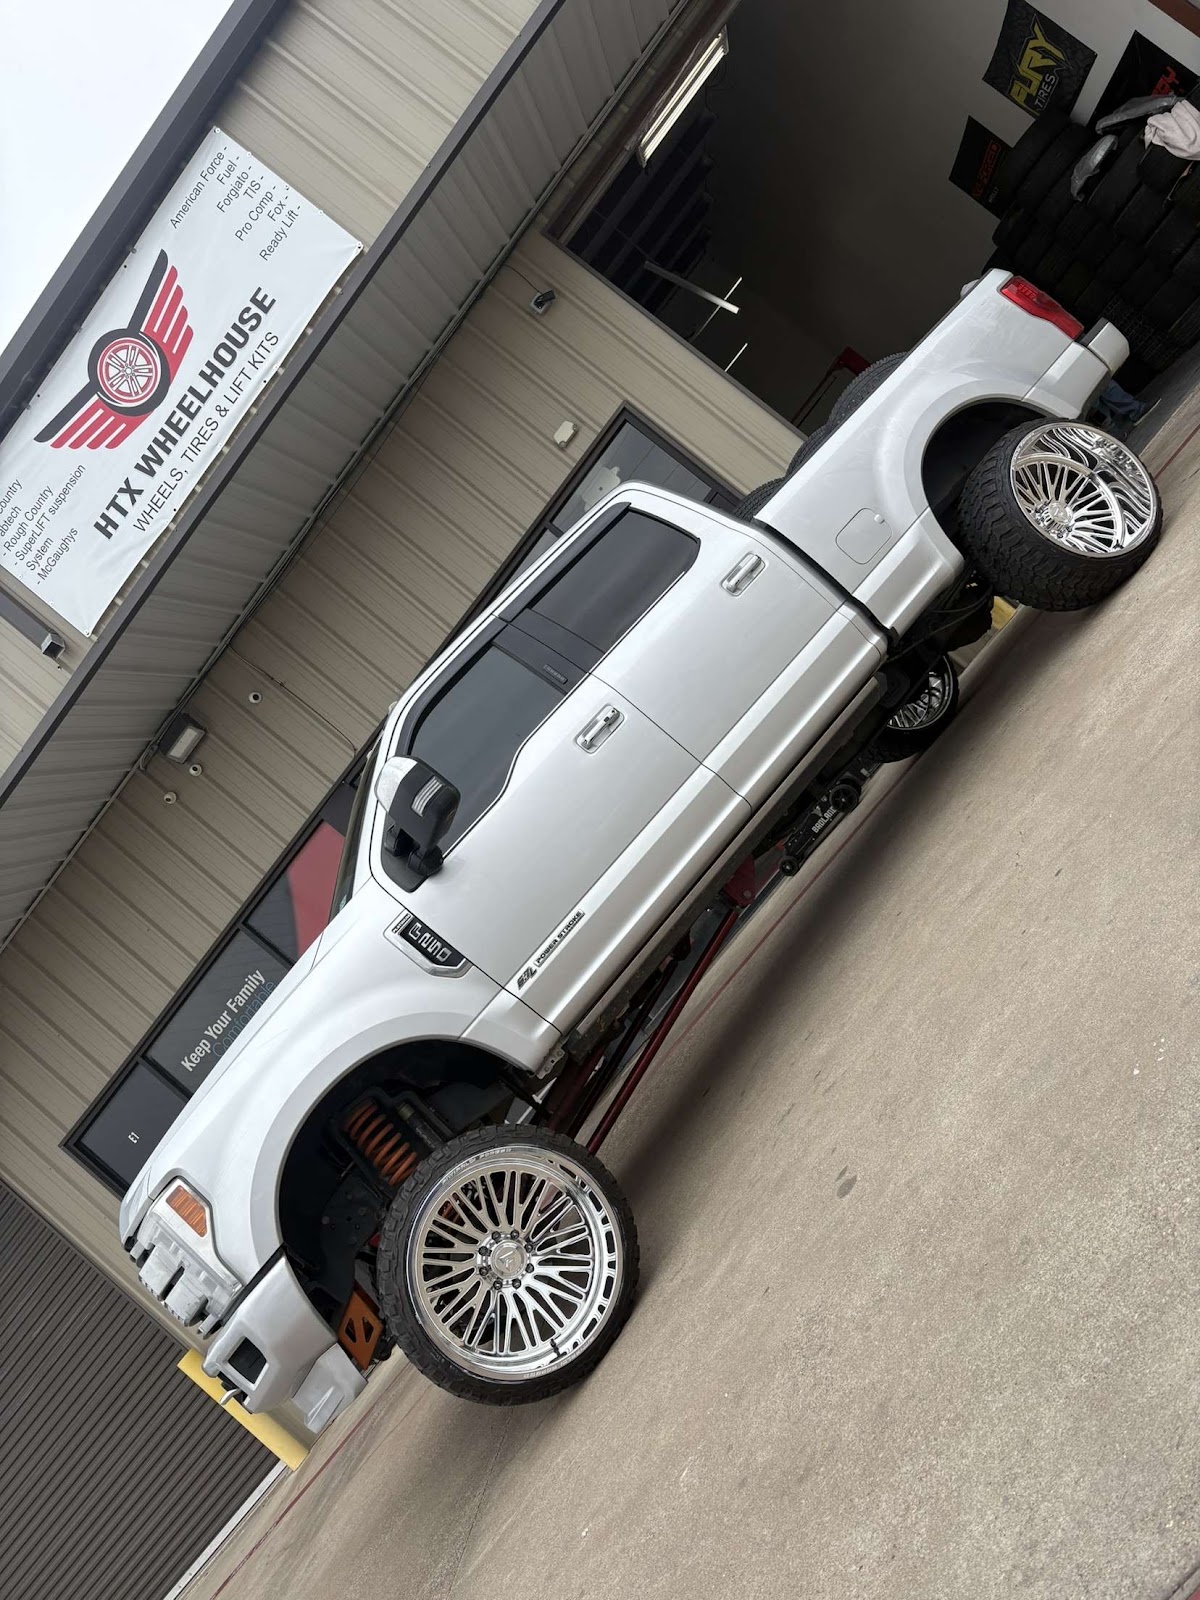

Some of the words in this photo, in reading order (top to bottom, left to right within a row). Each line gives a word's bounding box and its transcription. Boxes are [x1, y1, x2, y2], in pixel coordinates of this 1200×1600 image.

[1009, 22, 1066, 116] FURY
[1034, 73, 1056, 109] TIRES
[170, 181, 205, 229] American
[200, 151, 225, 182] Force
[216, 159, 238, 185] Fuel
[216, 171, 249, 213] Forgiato
[243, 180, 261, 199] TIS
[234, 222, 253, 242] Pro
[248, 193, 274, 221] Comp
[259, 227, 288, 261] Ready
[281, 210, 299, 229] Lift
[267, 200, 287, 222] Fox
[93, 477, 144, 540] HTX
[134, 286, 277, 478] WHEELHOUSE
[132, 467, 189, 532] WHEELS,
[180, 417, 219, 464] TIRES
[214, 403, 230, 418] &
[223, 367, 252, 405] LIFT
[247, 331, 280, 370] KITS
[0, 505, 22, 537] abtech
[3, 522, 29, 552] Rough
[24, 486, 54, 522] Country
[15, 513, 51, 561] SuperLIFT
[48, 464, 86, 516] suspension
[25, 537, 54, 571] System
[37, 527, 78, 581] McGaughys
[535, 939, 558, 964] POWER
[557, 911, 582, 939] STROKE
[181, 1039, 212, 1072] Keep
[204, 1010, 233, 1040] Your
[226, 970, 266, 1013] Family
[212, 981, 275, 1057] Comfortable
[128, 1131, 140, 1144] E1
